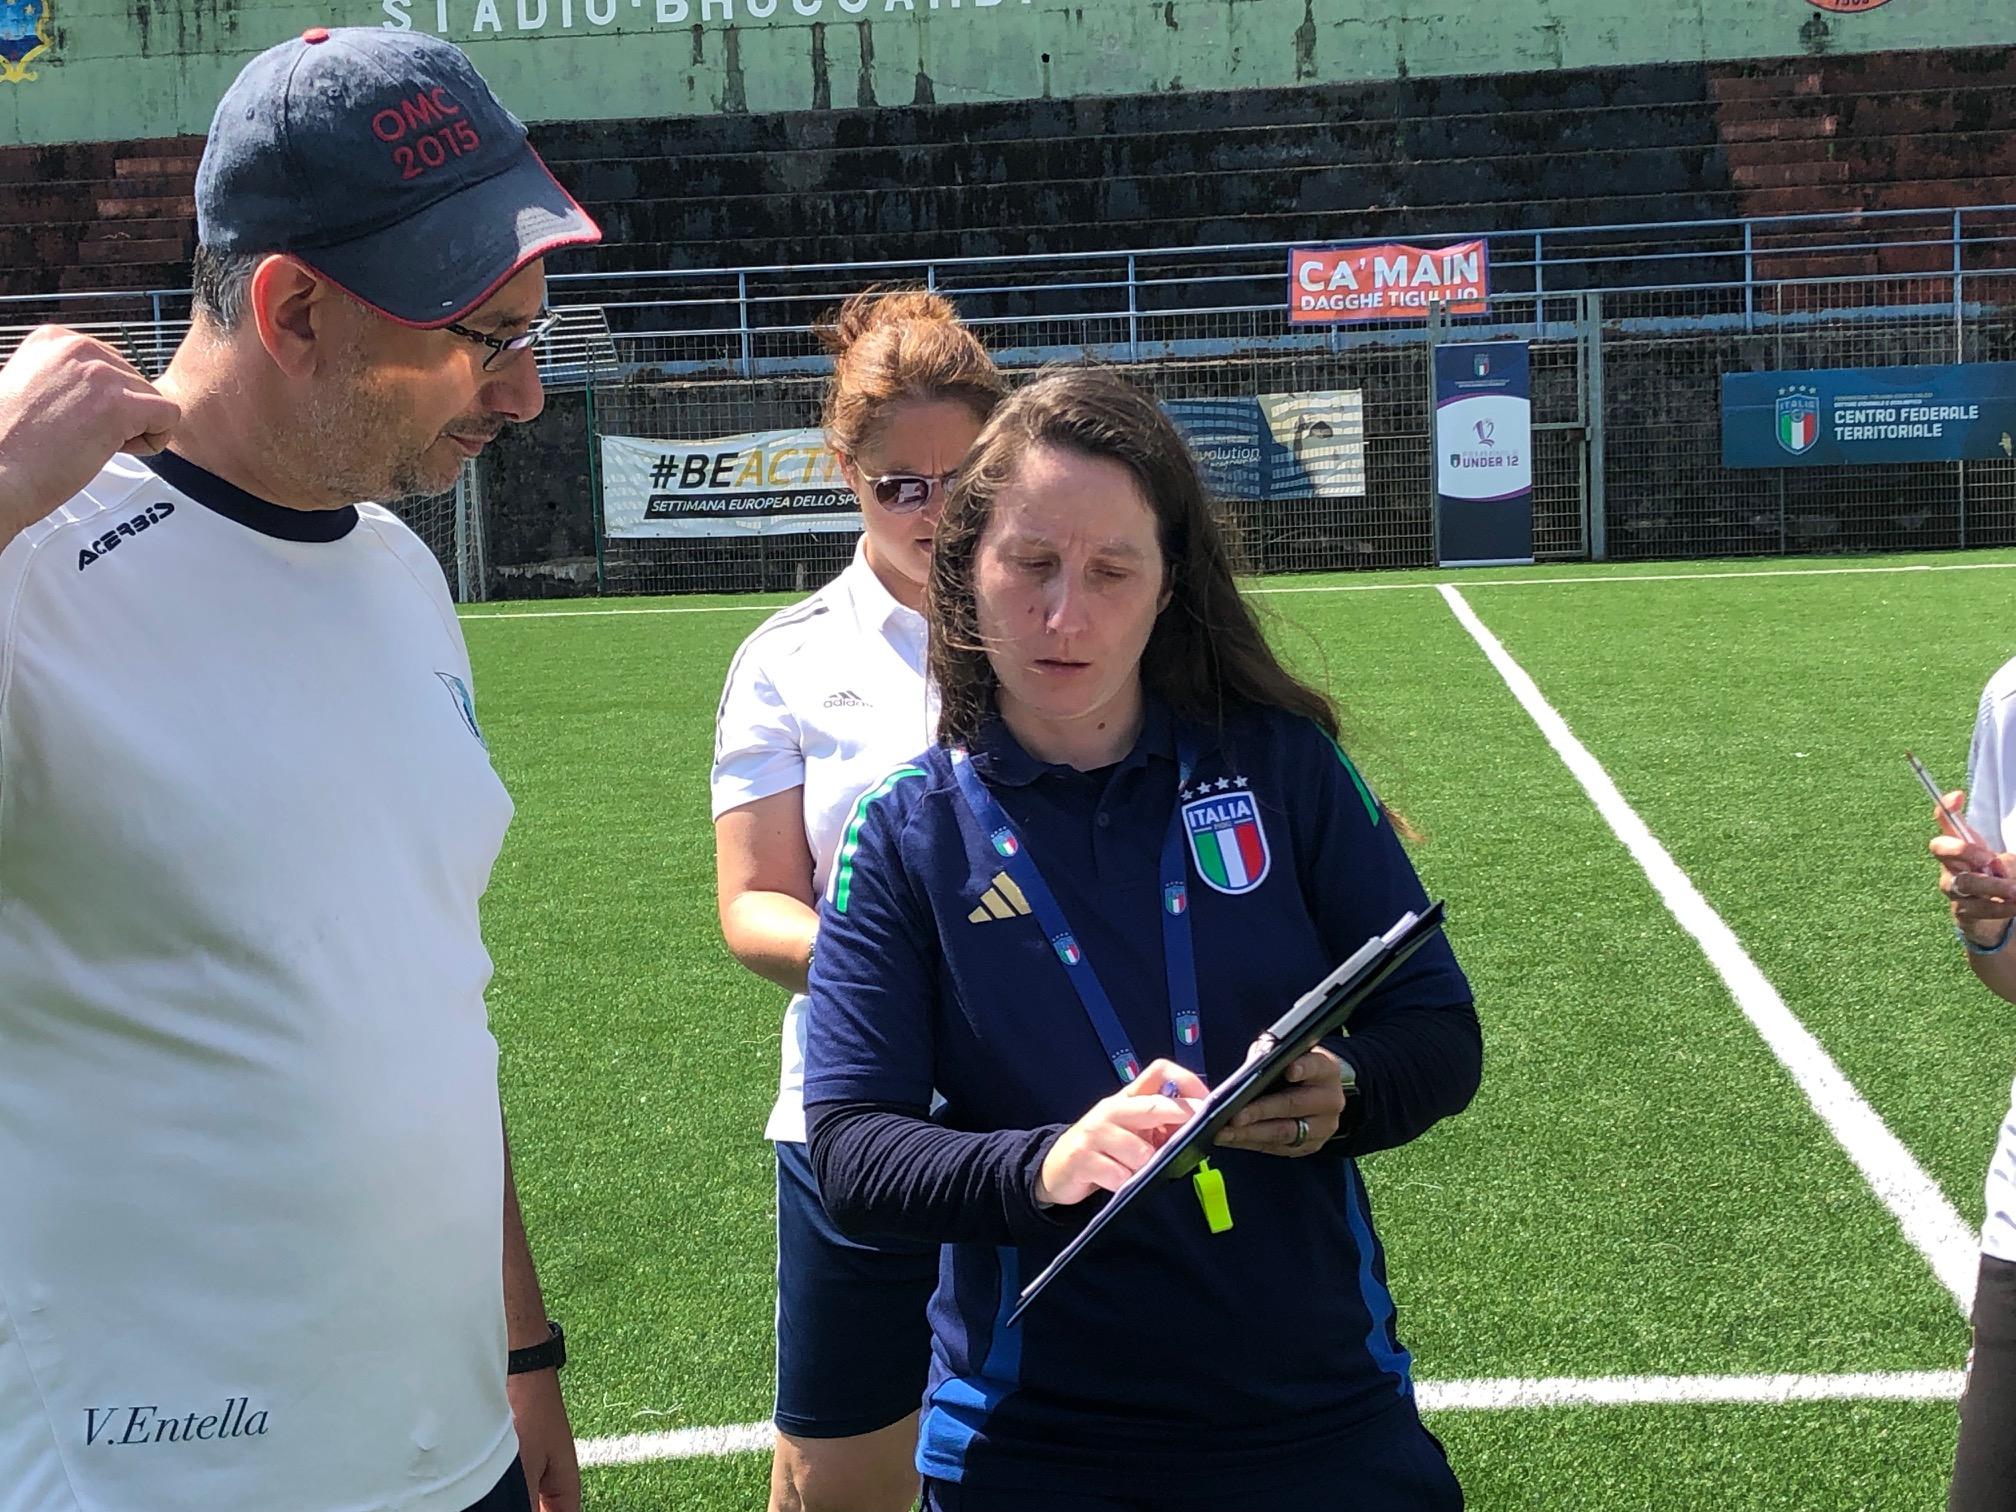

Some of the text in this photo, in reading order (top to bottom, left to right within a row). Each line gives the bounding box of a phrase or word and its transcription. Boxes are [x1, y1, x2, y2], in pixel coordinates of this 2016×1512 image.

[372, 86, 459, 142] OMC
[393, 118, 480, 180] 2015
[1300, 291, 1384, 311] DAGGHE
[1834, 405, 1979, 424] CENTRO FEDERALE
[1834, 423, 1943, 441] TERRITORIALE
[649, 447, 837, 490] #BEACTI
[1463, 455, 1519, 468] UNDER 12
[651, 493, 862, 513] SETTIMANA EUROPEA DELLO SPO
[1187, 800, 1252, 828] ITALIA
[83, 1397, 269, 1446] V.Entella
